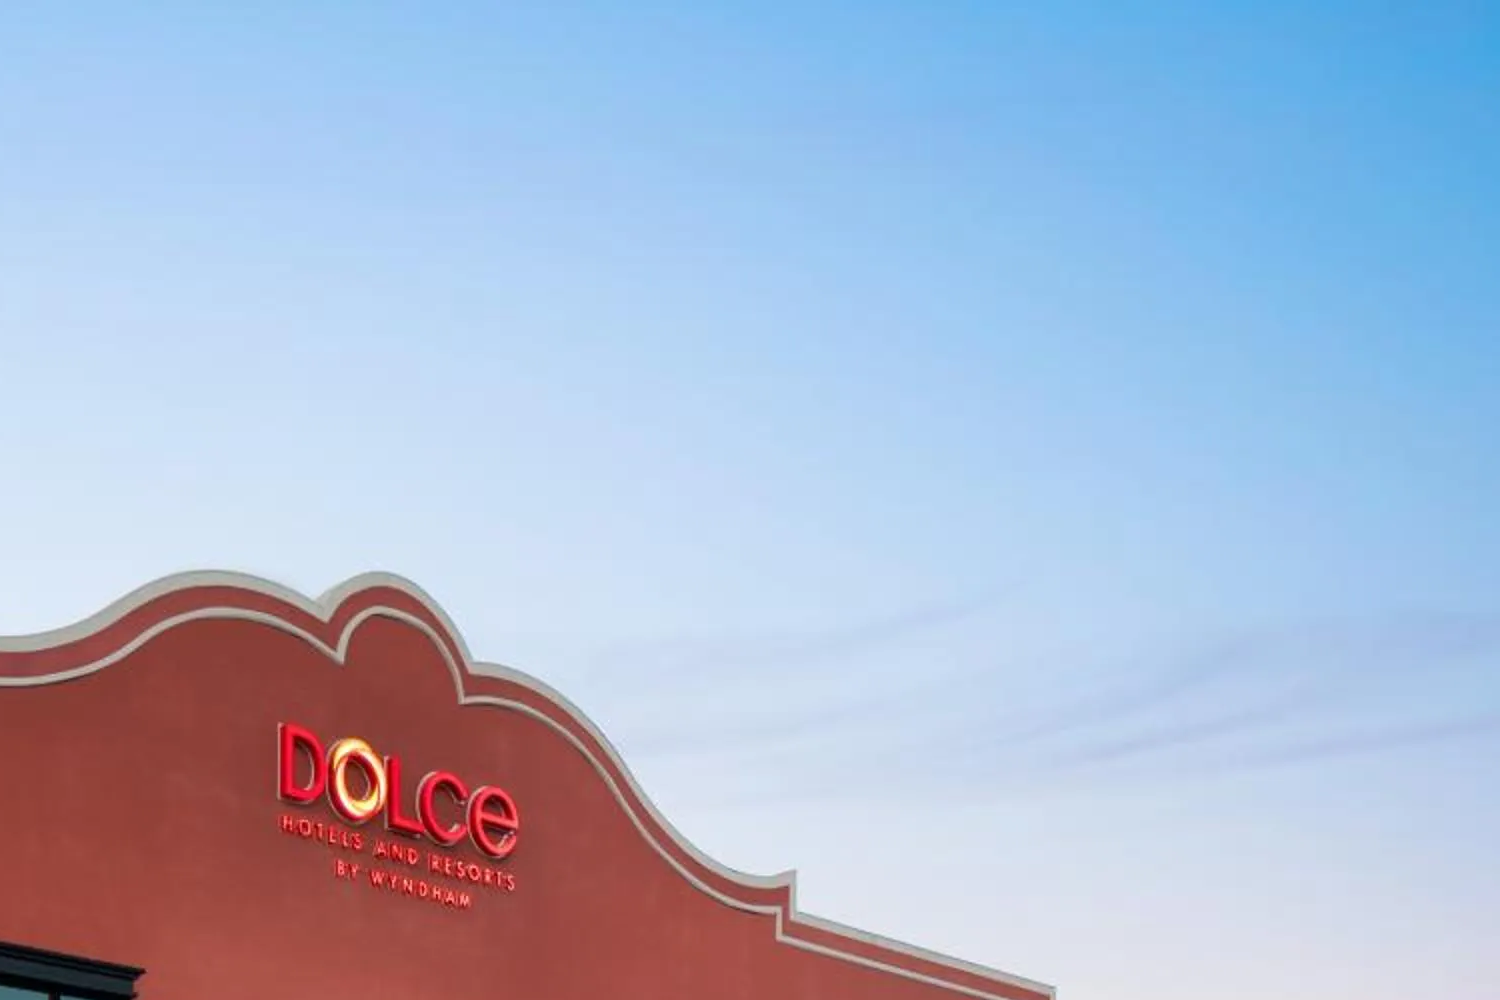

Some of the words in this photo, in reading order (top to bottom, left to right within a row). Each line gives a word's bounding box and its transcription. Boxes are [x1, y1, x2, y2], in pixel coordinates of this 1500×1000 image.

[280, 816, 363, 849] HOTELS
[374, 841, 419, 865] AND
[429, 852, 516, 891] RESORTS
[335, 859, 360, 879] BY
[370, 871, 471, 908] WYNDHAM
